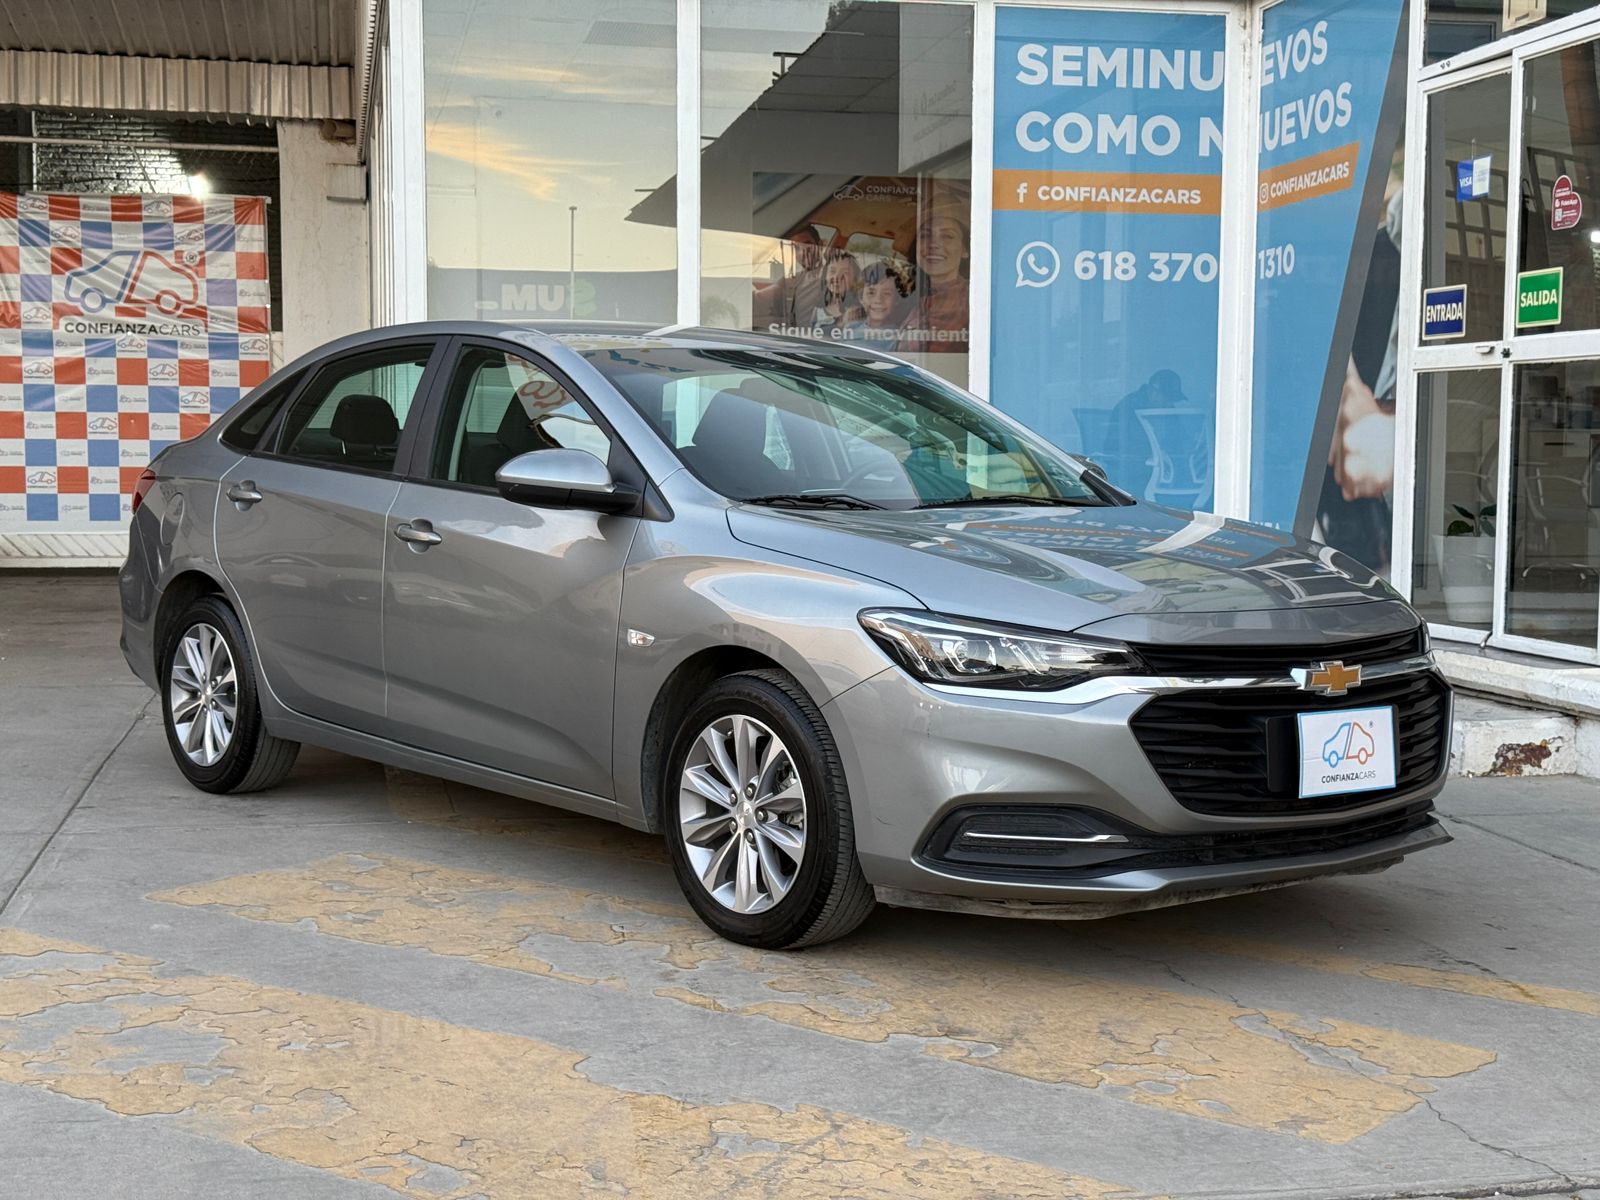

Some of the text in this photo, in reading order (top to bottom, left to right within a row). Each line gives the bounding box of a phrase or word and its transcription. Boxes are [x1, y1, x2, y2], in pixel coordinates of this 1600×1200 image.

[1015, 110, 1181, 156] COMO
[1270, 161, 1350, 199] CONFIANZACARS
[1037, 184, 1201, 204] CONFIANZACARS
[1073, 250, 1218, 283] 618 370
[1258, 243, 1295, 280] 1310
[1520, 288, 1558, 308] SALIDA
[1426, 302, 1463, 323] ENTRADA
[64, 322, 201, 336] CONFIANZACARS
[831, 327, 854, 339] en
[1321, 770, 1377, 784] CONFIANZACARS
